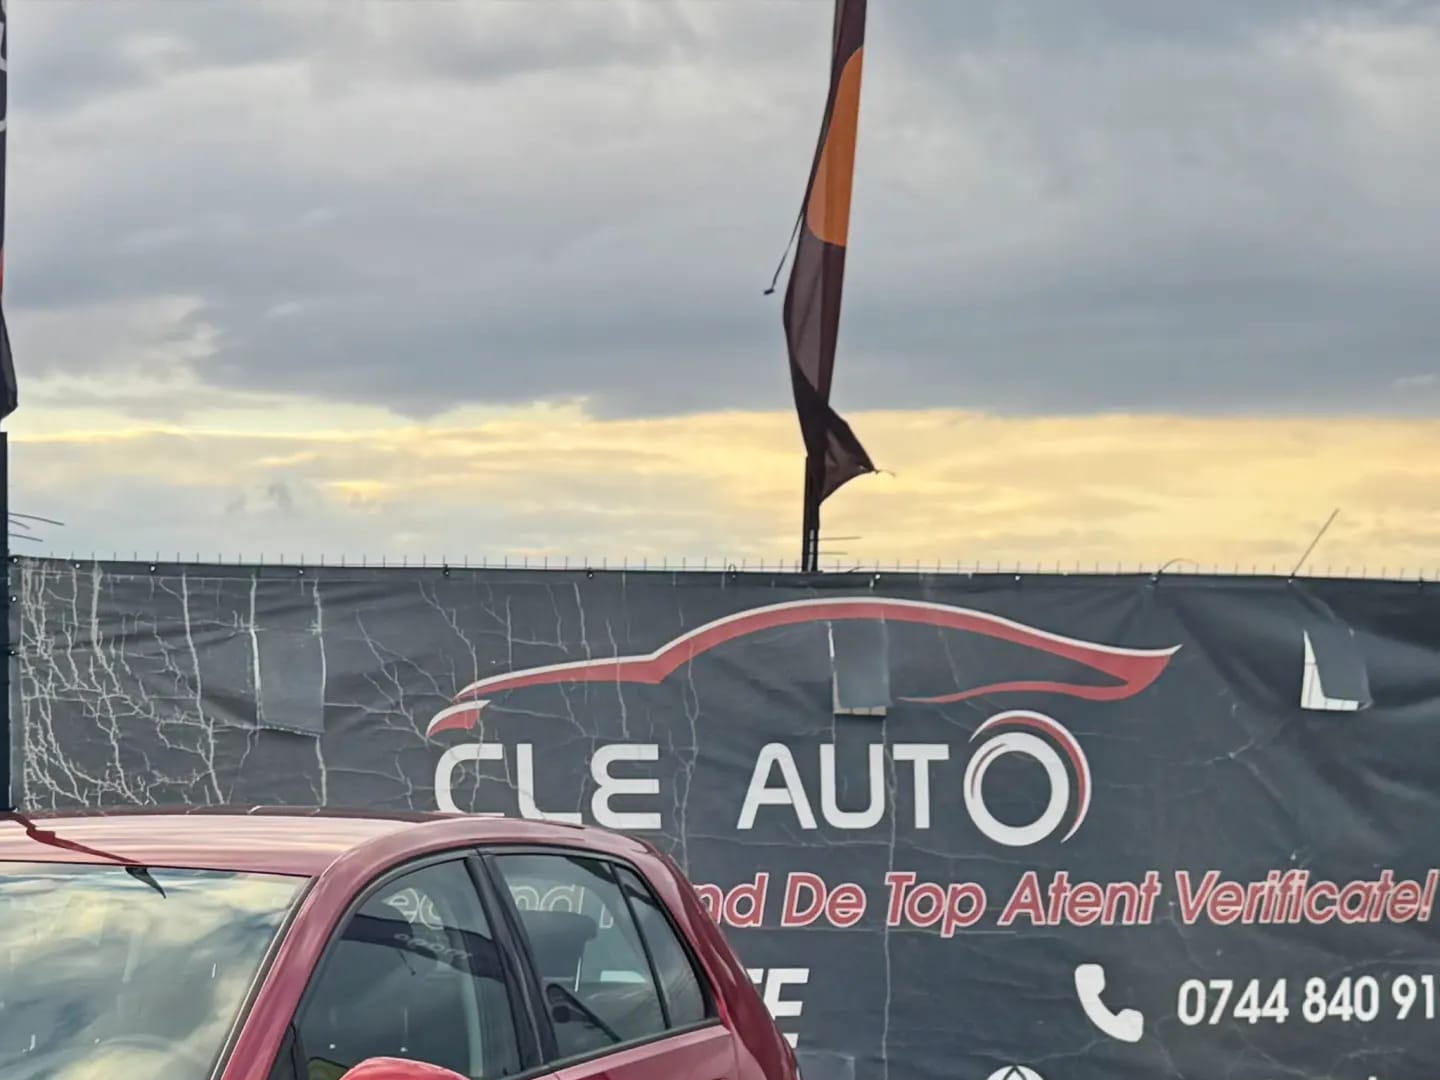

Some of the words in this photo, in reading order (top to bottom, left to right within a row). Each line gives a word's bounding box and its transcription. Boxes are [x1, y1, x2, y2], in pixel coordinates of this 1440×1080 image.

[434, 742, 661, 830] CLE
[737, 731, 1071, 847] AUTO
[781, 872, 867, 928] De
[885, 871, 987, 938] Top
[997, 870, 1161, 926] Atent
[1175, 869, 1440, 925] Verificate!
[1177, 978, 1290, 1026] 0744
[1302, 976, 1380, 1023] 840
